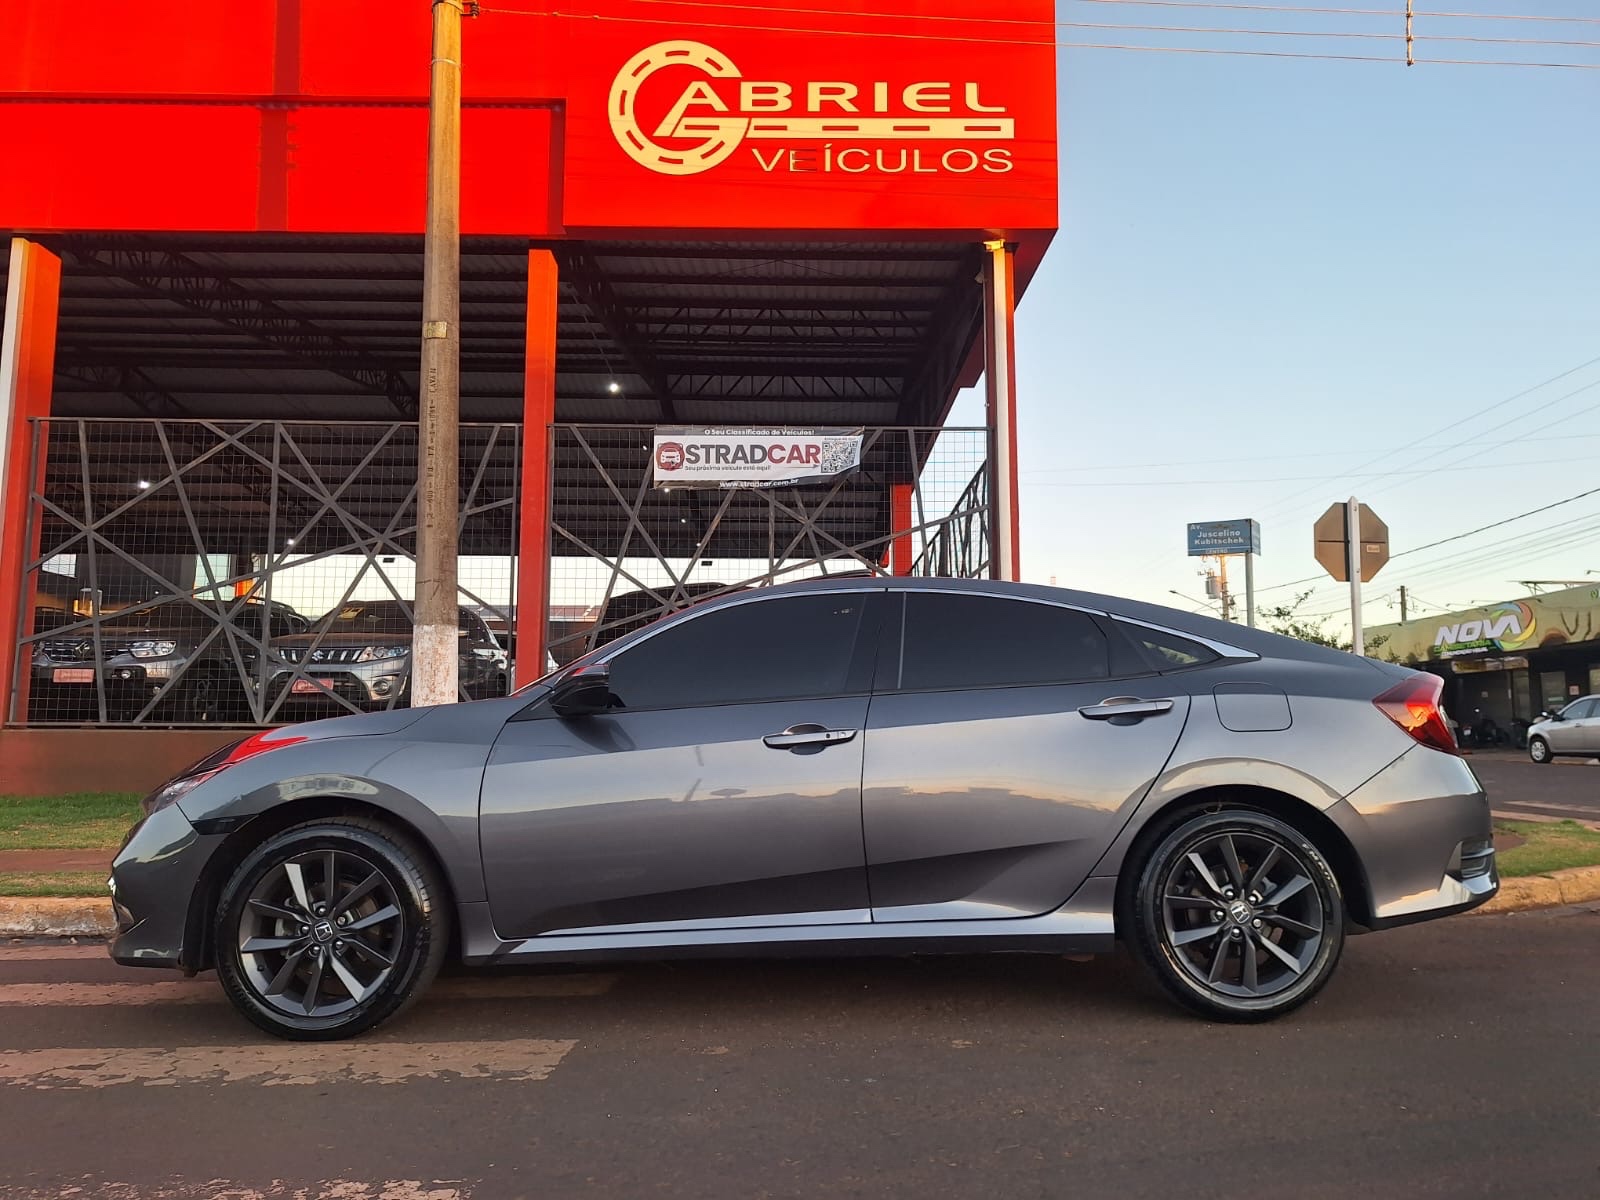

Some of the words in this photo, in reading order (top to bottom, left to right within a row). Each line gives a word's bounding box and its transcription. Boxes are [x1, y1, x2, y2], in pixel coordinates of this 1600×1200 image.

[751, 143, 1014, 173] VEÍCULOS
[685, 444, 821, 465] STRADCAR
[1194, 537, 1244, 545] Kubitschek
[1197, 529, 1241, 538] Juscelino
[1434, 614, 1522, 646] NOVA
